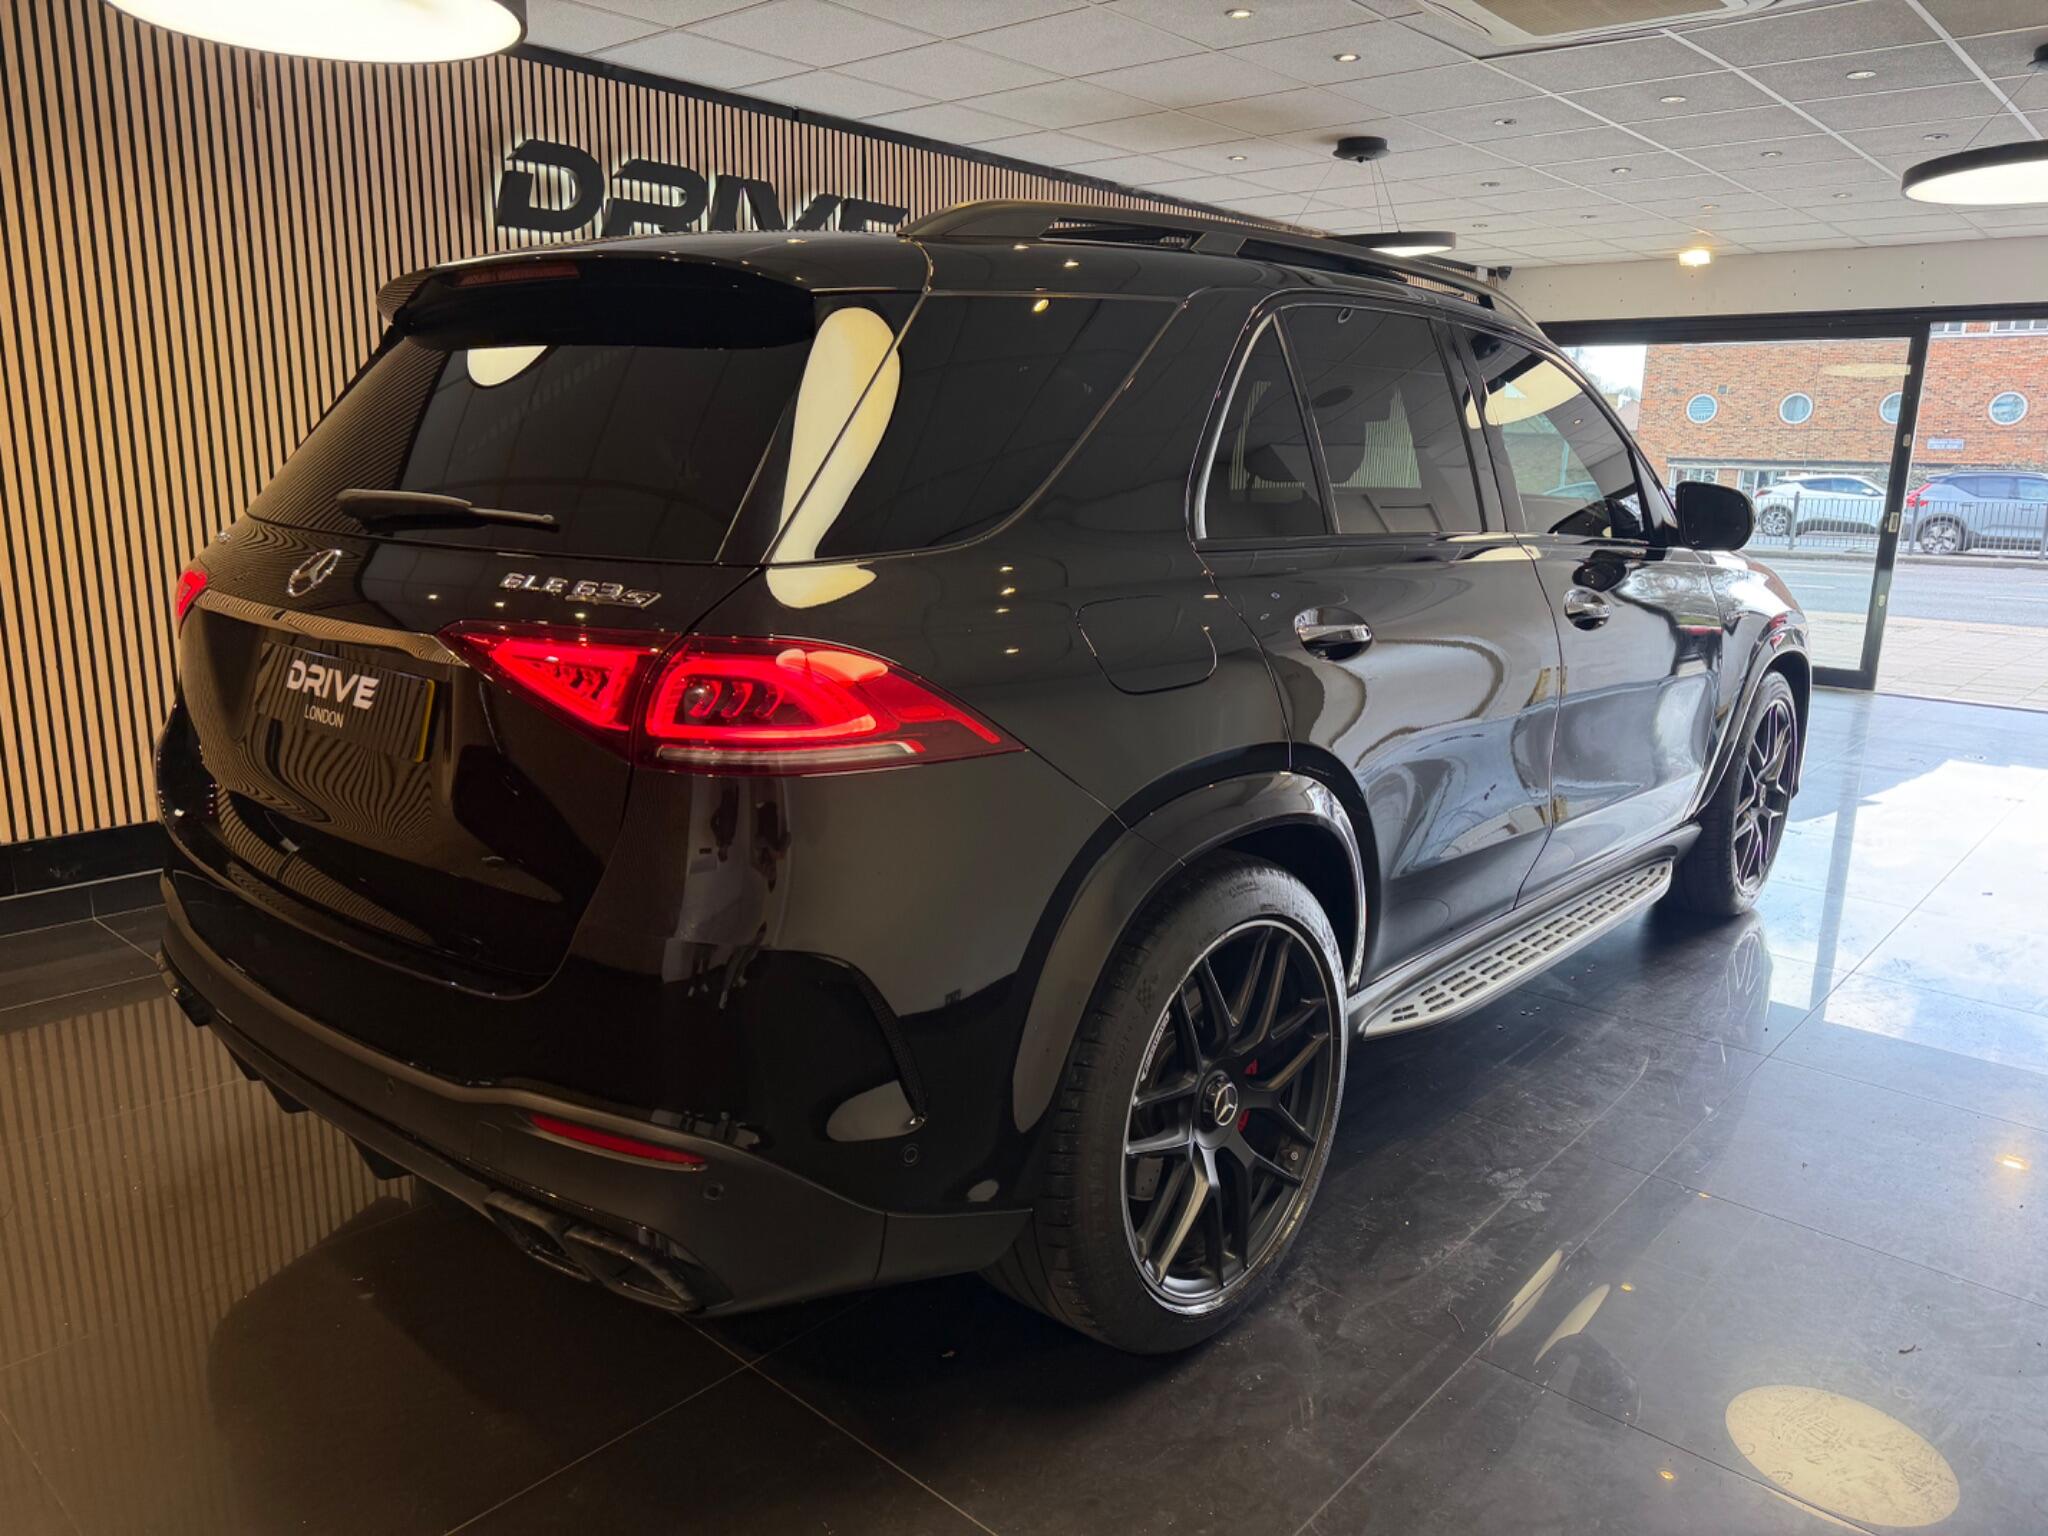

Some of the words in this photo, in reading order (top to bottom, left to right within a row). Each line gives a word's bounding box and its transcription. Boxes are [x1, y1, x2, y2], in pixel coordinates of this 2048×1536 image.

[500, 572, 568, 594] GLE
[286, 659, 380, 710] DRIVE
[303, 703, 345, 729] LONDON
